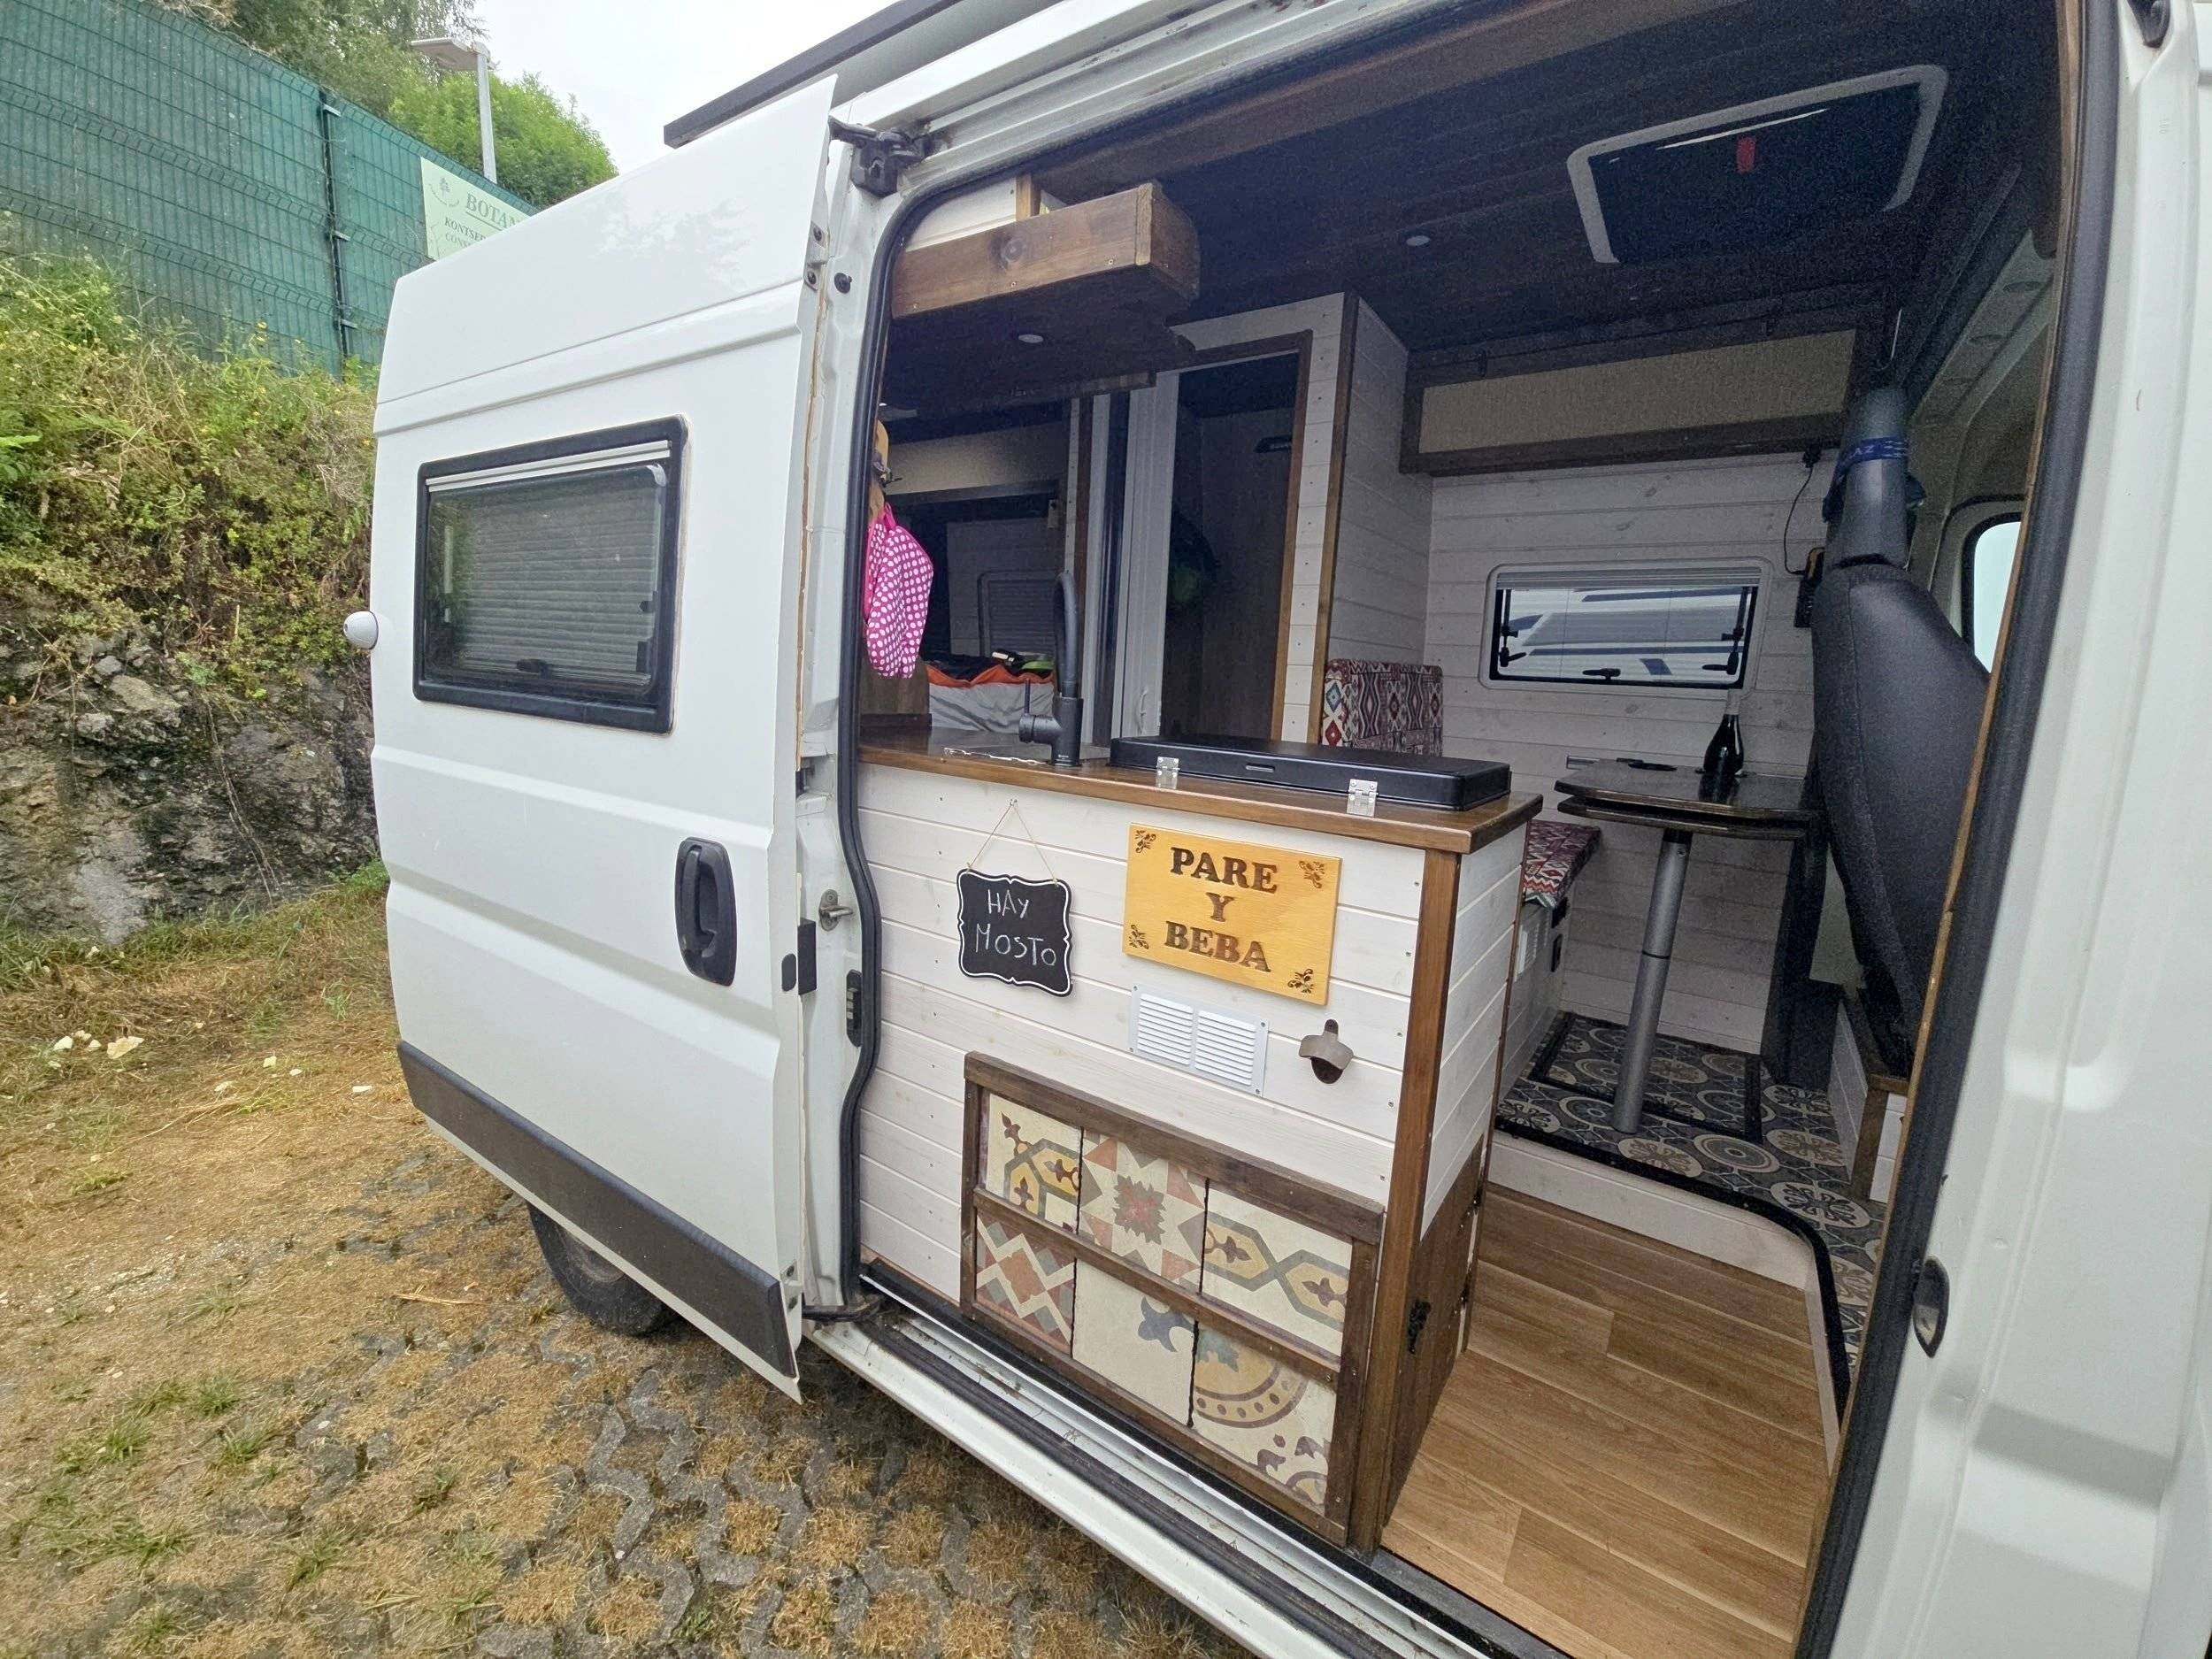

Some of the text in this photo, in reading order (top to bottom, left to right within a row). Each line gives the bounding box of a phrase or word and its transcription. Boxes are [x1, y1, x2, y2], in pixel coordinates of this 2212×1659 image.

[1170, 846, 1278, 894] PARE
[987, 888, 1030, 919] HAY
[1205, 891, 1235, 923] Y
[975, 923, 1057, 966] MOSTO
[1164, 920, 1271, 973] BEBA
